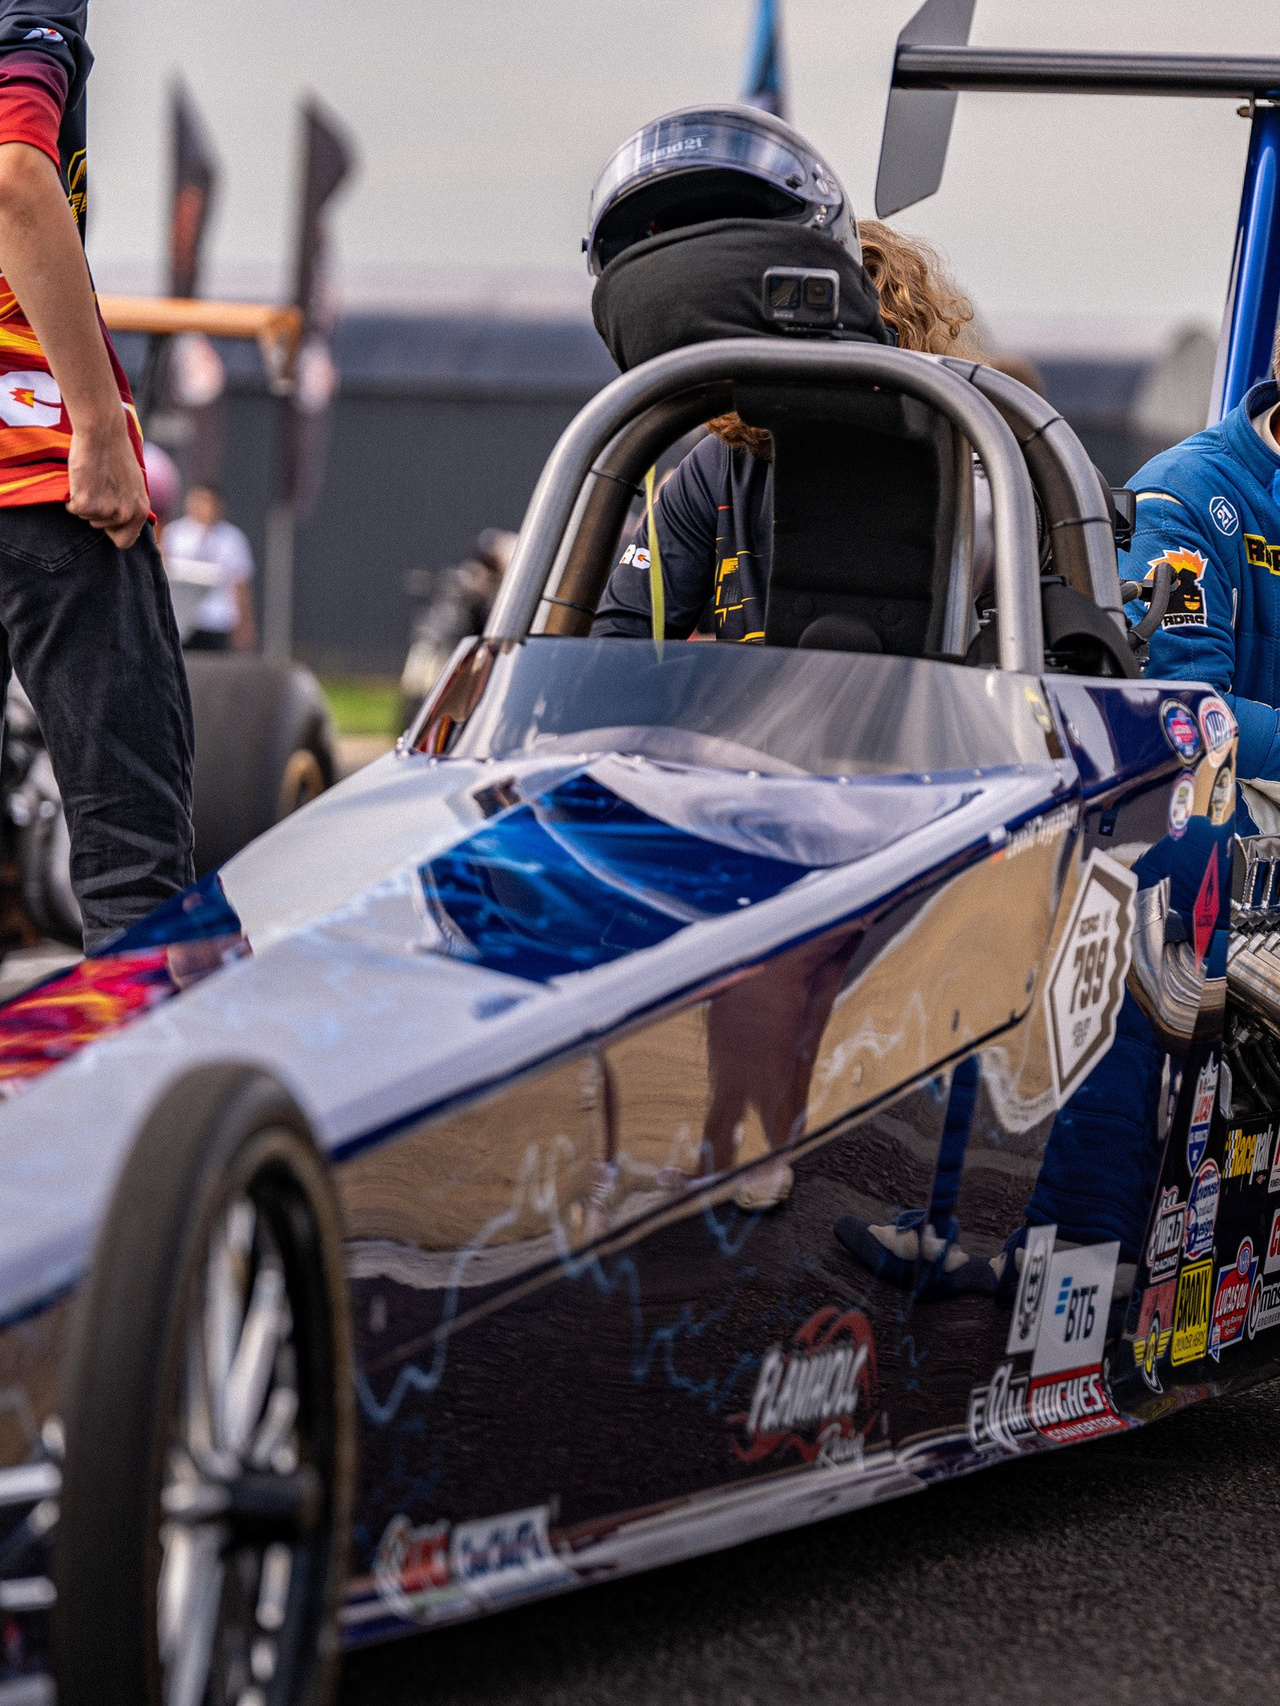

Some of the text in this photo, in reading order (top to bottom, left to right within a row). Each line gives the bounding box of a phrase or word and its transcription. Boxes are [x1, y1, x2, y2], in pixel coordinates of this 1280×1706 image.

[1217, 505, 1233, 528] 21
[1163, 614, 1204, 627] RDRC
[1069, 936, 1110, 1015] 799
[1064, 1284, 1099, 1343] ВТБ
[1216, 1283, 1249, 1318] LUCAS OIL
[1030, 1373, 1105, 1427] HUGHES
